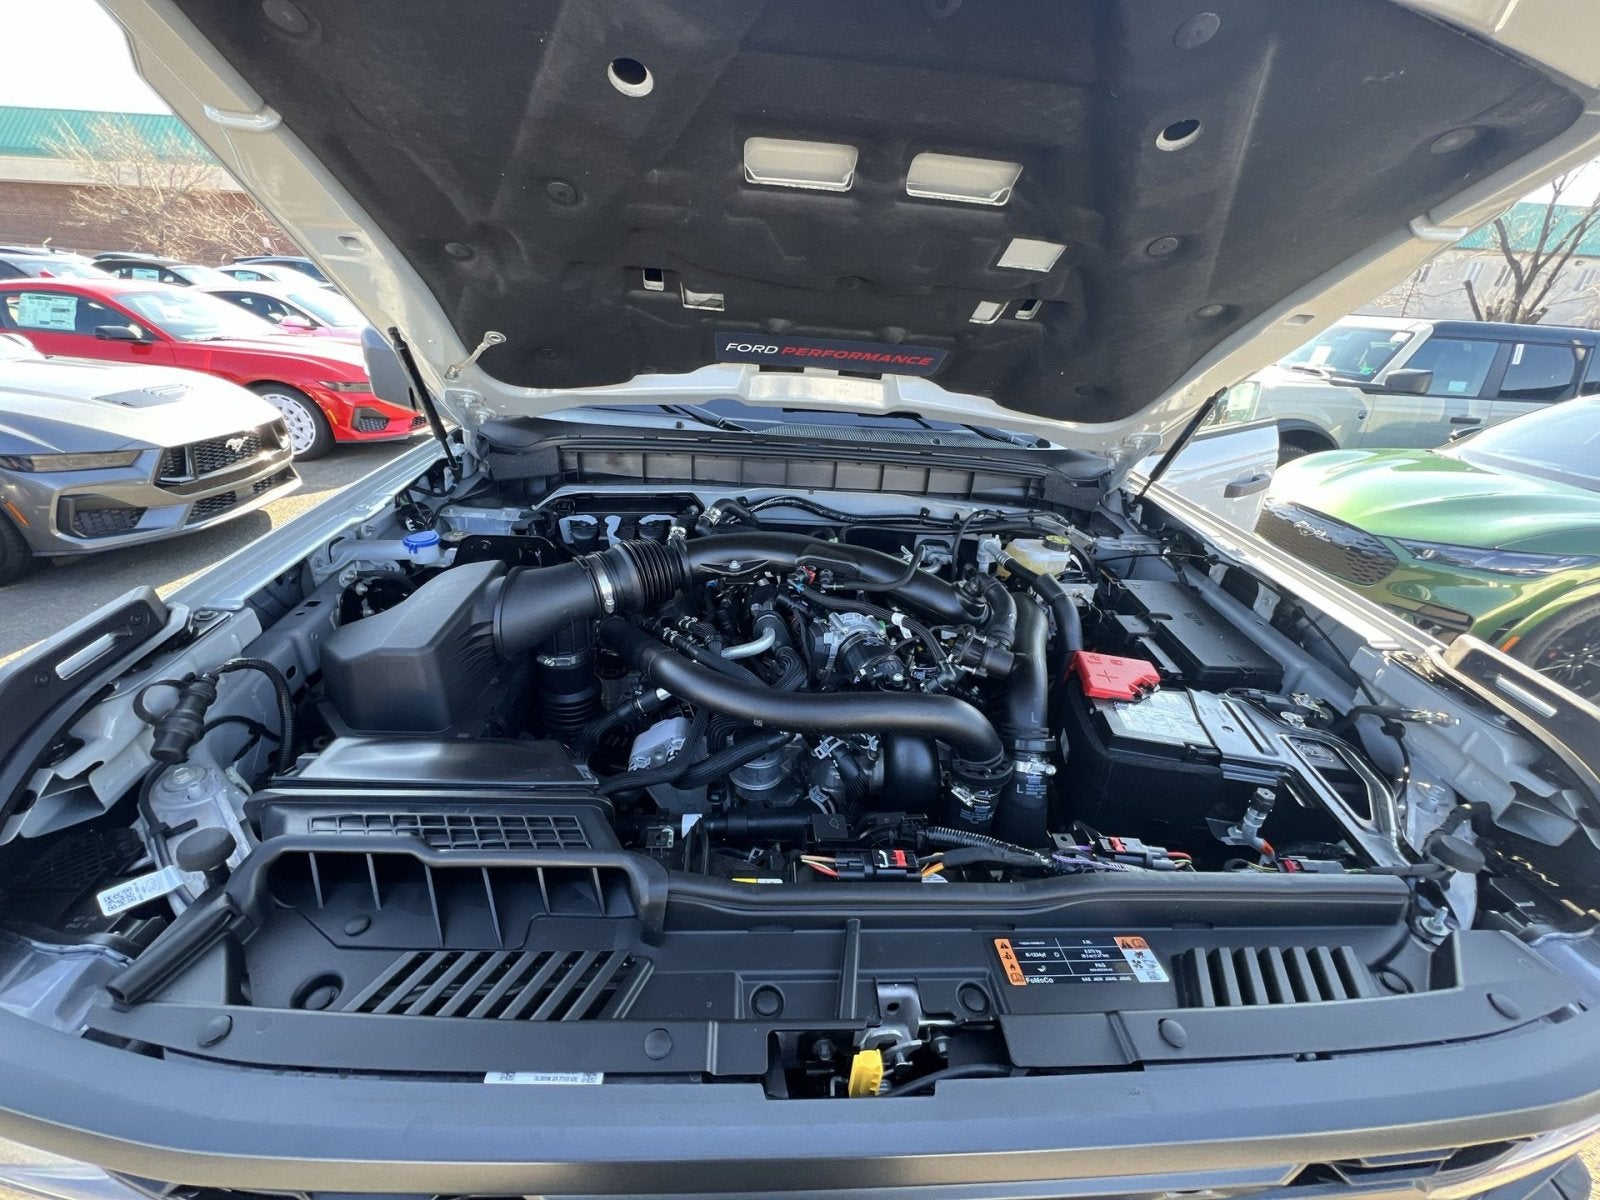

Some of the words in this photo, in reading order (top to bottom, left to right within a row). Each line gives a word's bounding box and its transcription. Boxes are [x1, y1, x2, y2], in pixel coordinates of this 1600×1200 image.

[725, 343, 779, 354] FORD
[781, 346, 934, 366] PERFORMANCE
[1031, 711, 1039, 723] L
[1016, 783, 1025, 794] L
